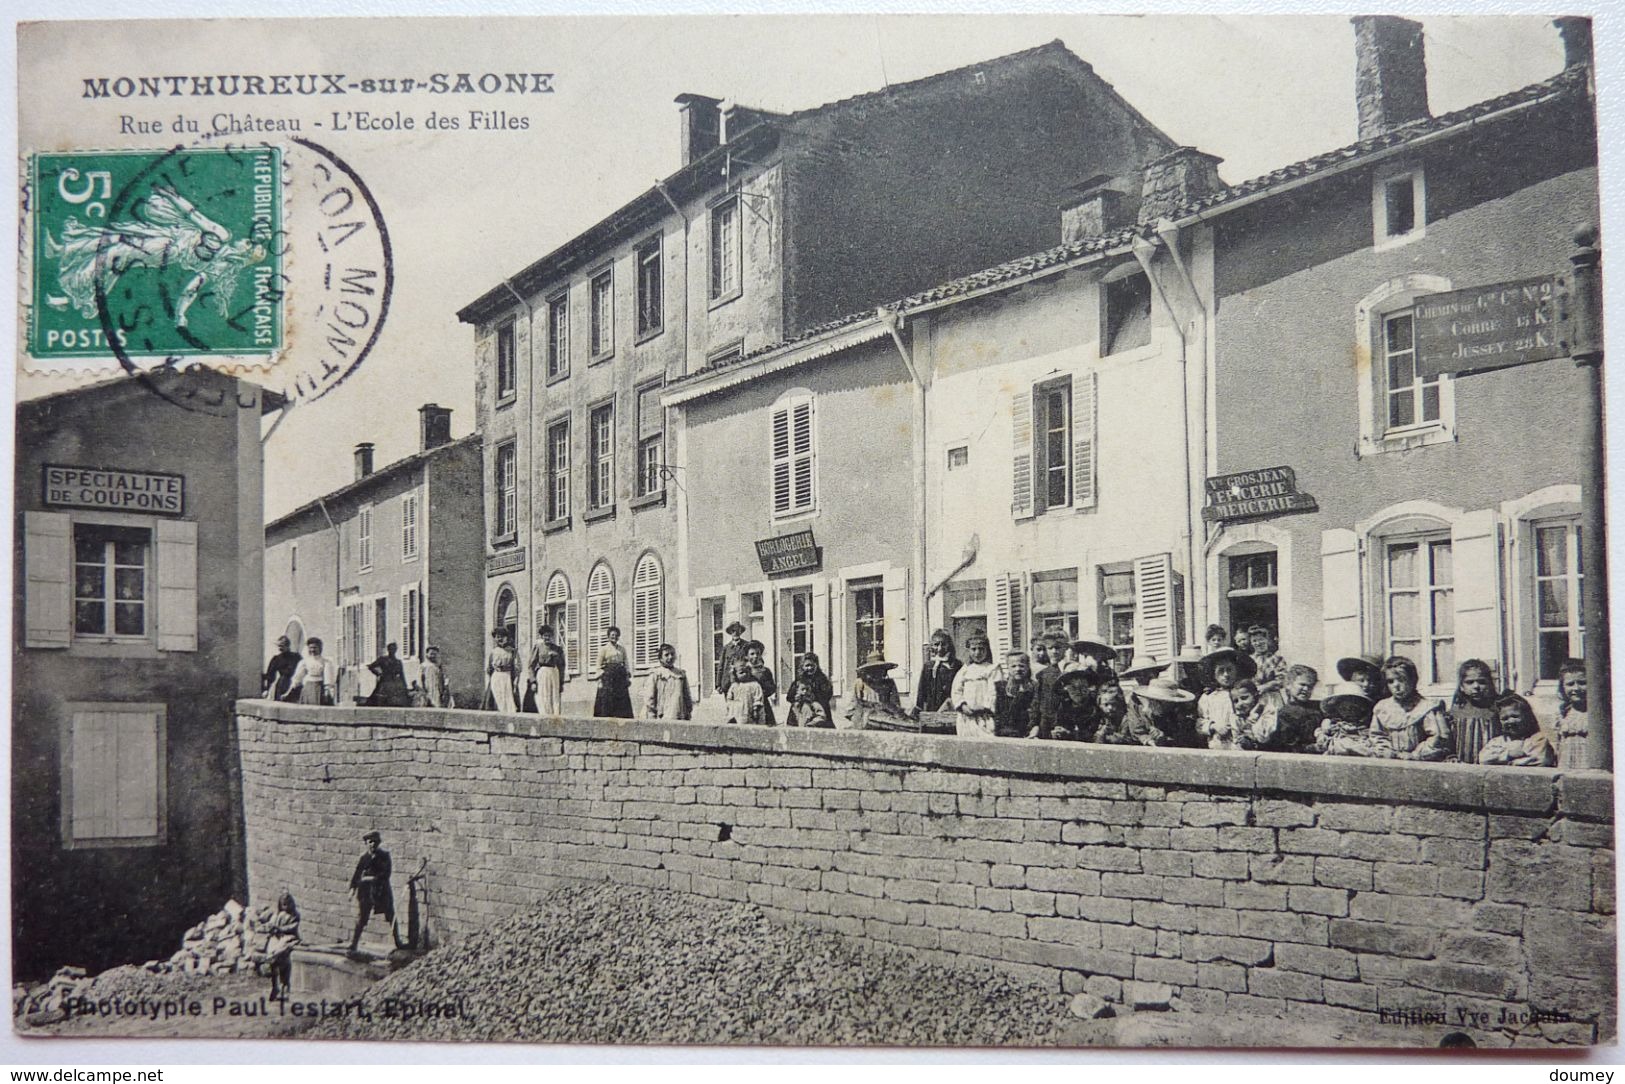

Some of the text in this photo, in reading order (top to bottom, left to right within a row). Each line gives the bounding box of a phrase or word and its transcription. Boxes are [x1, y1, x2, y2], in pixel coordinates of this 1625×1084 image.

[1540, 282, 1552, 301] 2
[50, 469, 179, 494] SPÉCIALITÉ
[1227, 469, 1288, 487] GROSJEAN
[51, 488, 178, 510] DE COUPONS
[1216, 496, 1297, 517] MERCERIE
[759, 533, 813, 556] HORLOGERIE
[772, 553, 807, 570] ANGEL
